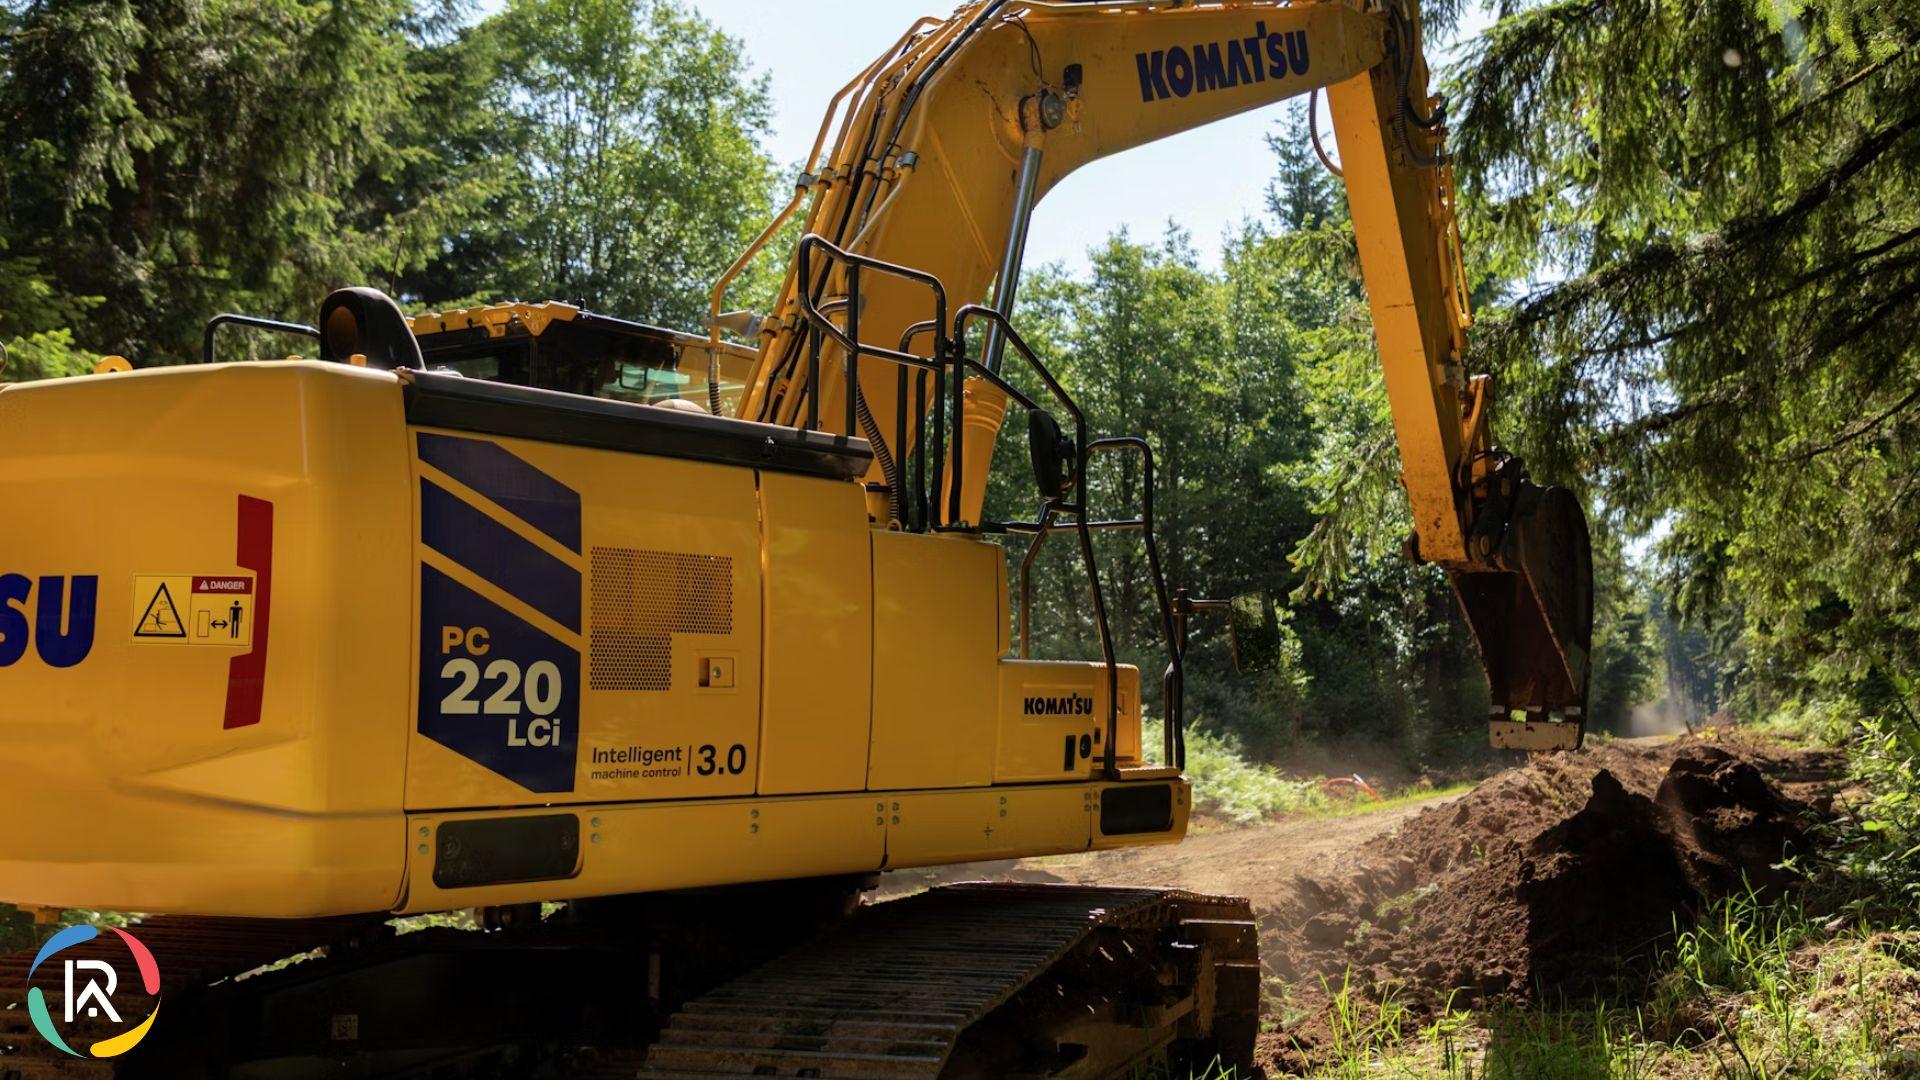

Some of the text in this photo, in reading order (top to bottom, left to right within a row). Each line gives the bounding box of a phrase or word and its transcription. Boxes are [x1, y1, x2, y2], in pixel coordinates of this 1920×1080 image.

[1136, 21, 1310, 102] KOMATSU
[210, 580, 245, 590] DANGER
[442, 626, 490, 656] PC
[440, 658, 562, 716] 220
[1024, 693, 1092, 715] KOMATSU
[507, 718, 560, 747] LCi
[592, 746, 682, 766] Intelligent
[697, 744, 747, 776] 3.0
[591, 766, 682, 780] machine control
